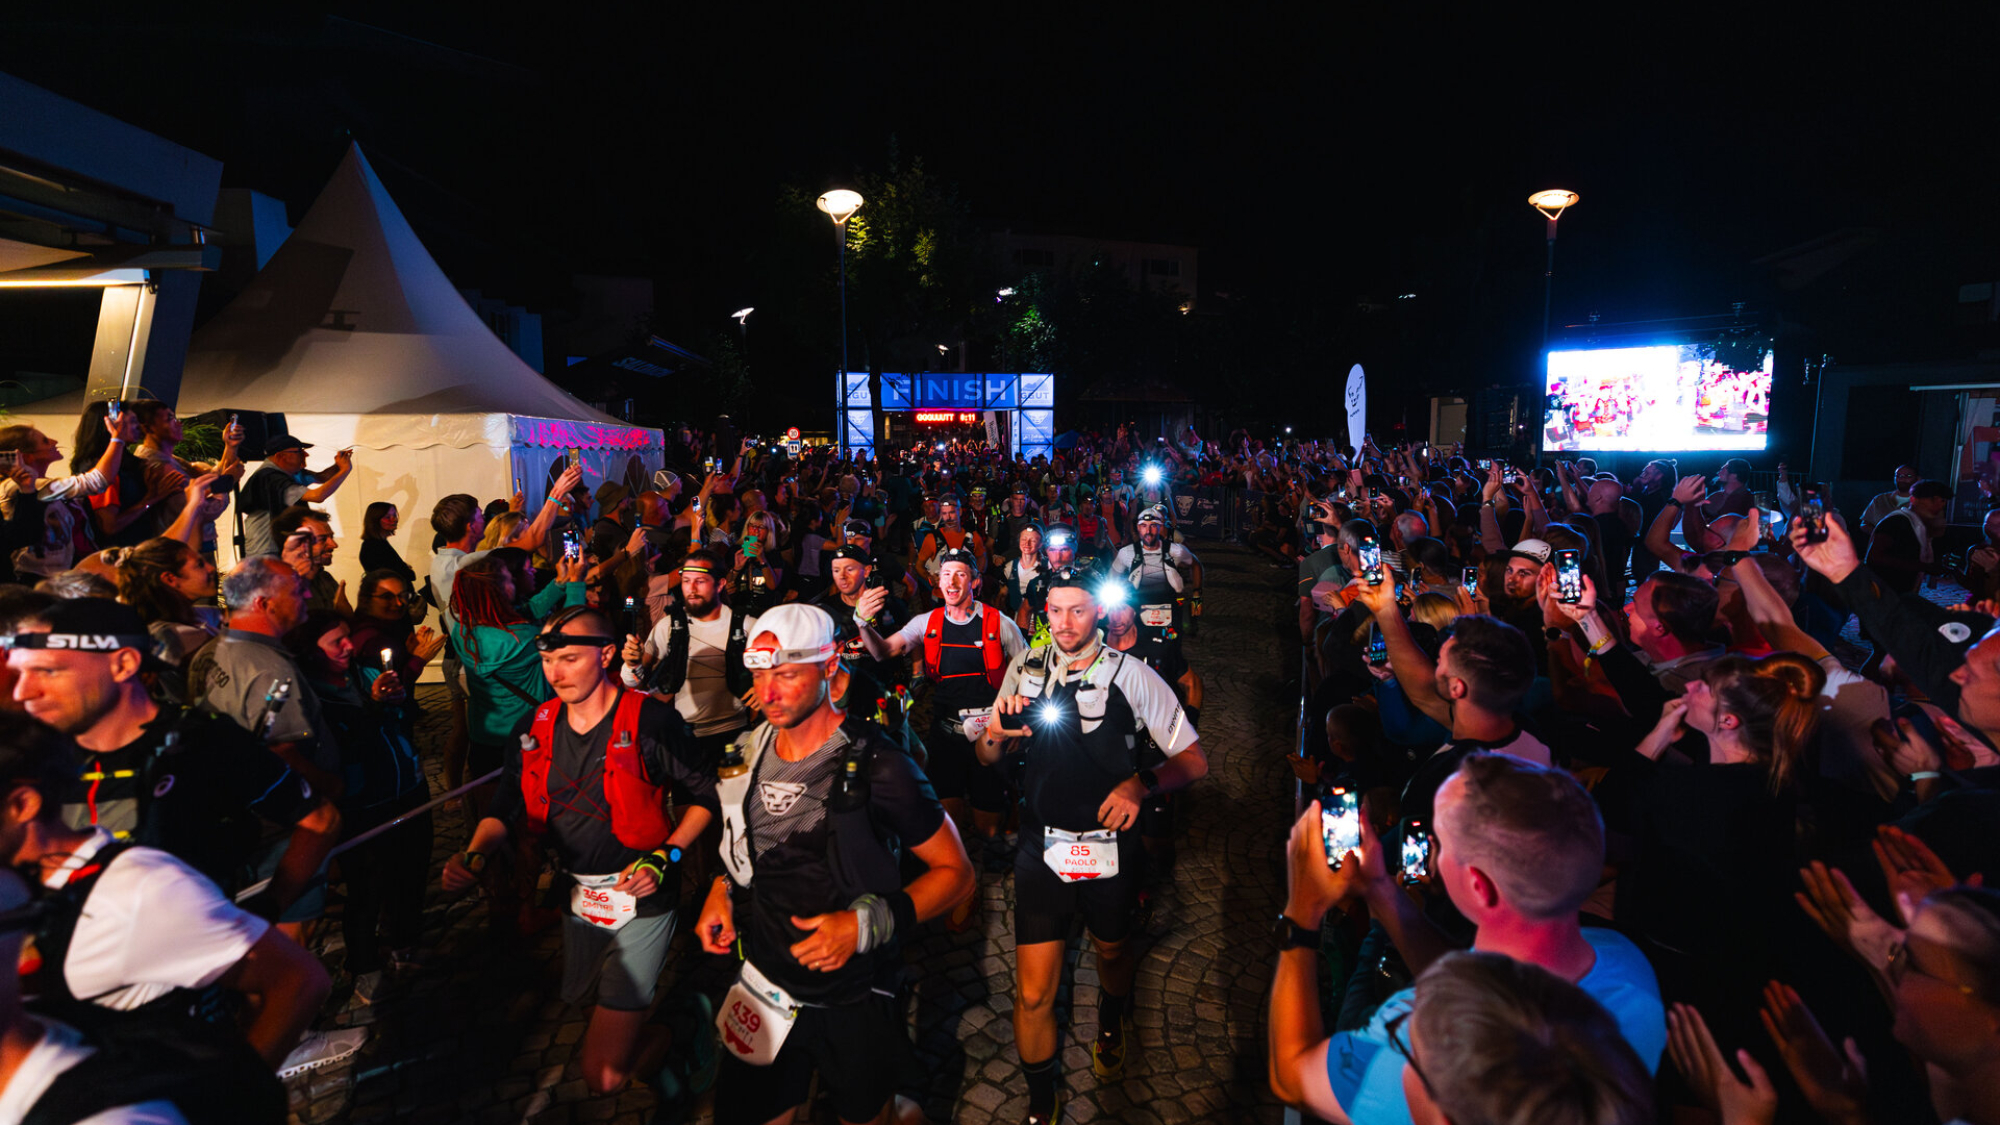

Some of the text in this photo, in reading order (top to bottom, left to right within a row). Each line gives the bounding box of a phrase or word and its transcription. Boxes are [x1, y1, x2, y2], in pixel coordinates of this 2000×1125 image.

[893, 379, 1006, 401] FINISH
[46, 633, 120, 649] SILVA
[1070, 845, 1091, 856] 85
[732, 1001, 760, 1033] 439
